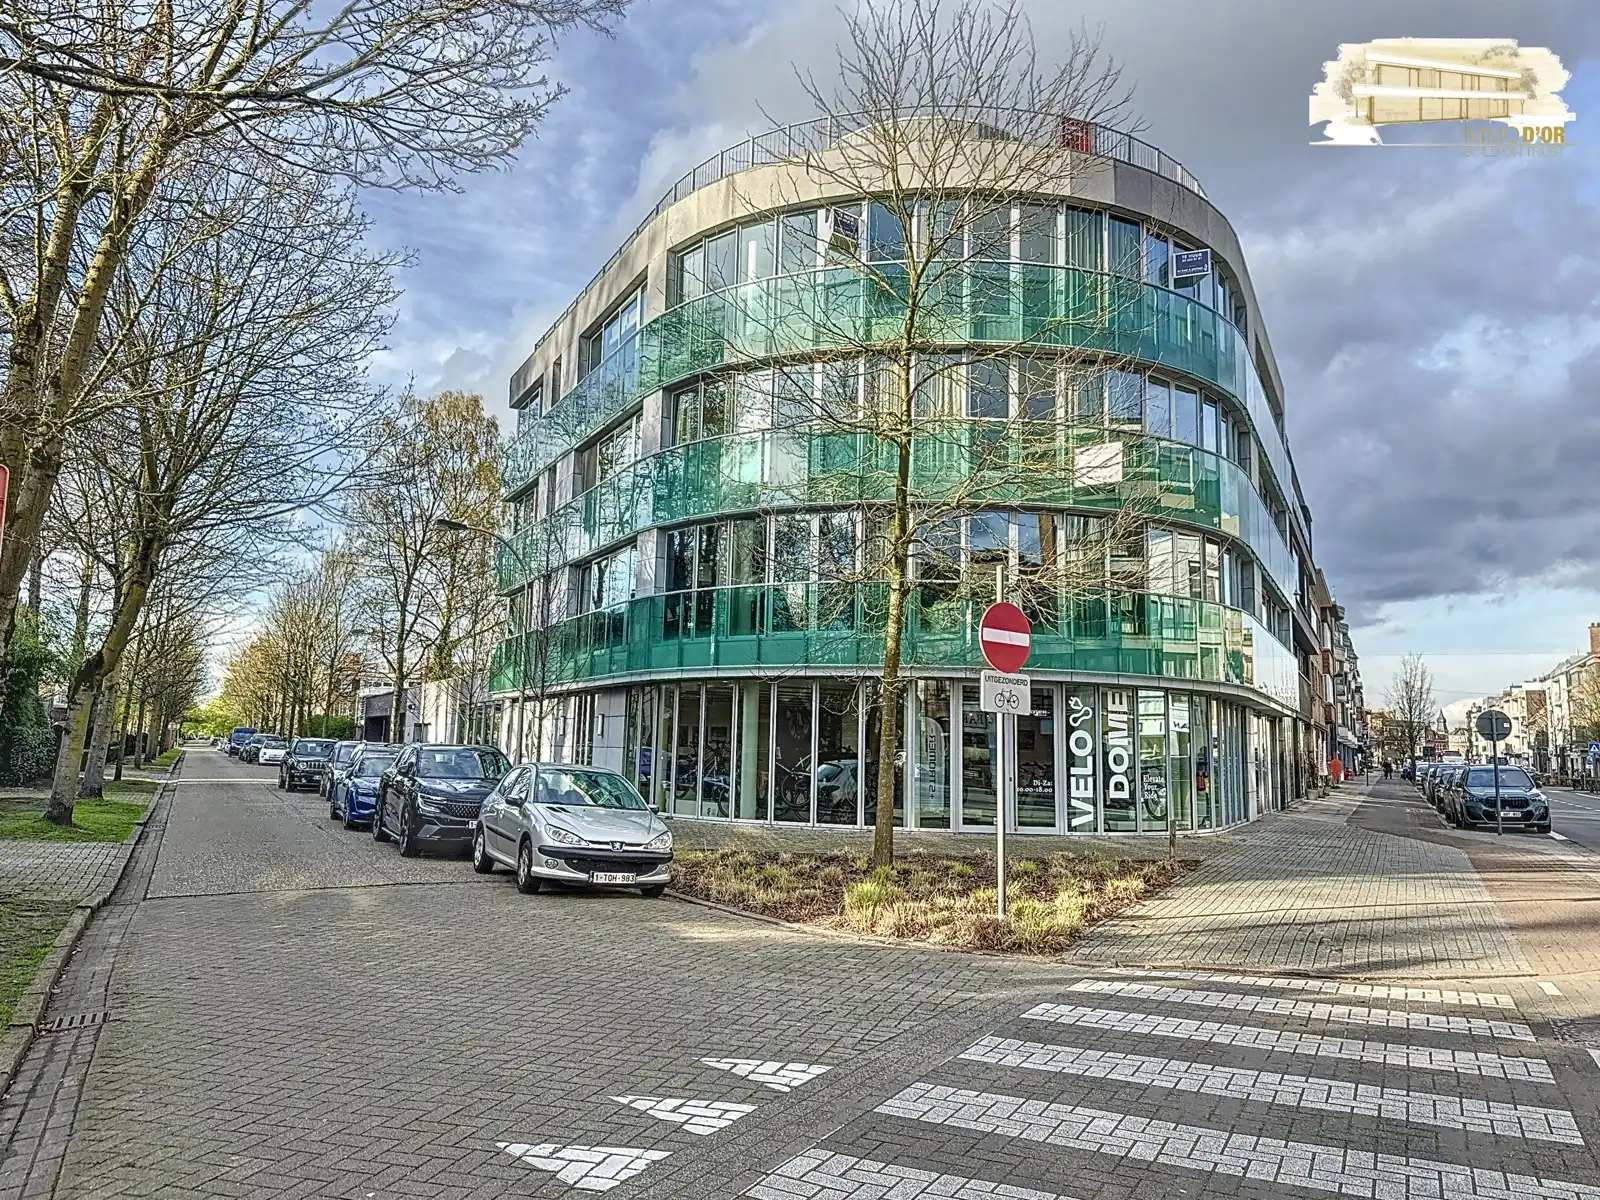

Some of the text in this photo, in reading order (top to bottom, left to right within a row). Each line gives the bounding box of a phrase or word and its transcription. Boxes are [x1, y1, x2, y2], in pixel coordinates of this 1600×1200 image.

[984, 674, 1028, 687] UITGEZONDERD
[1108, 691, 1129, 798] DOME
[1069, 730, 1093, 827] VELO
[1143, 775, 1164, 783] Elevate
[595, 873, 635, 883] 1-TOH-983
